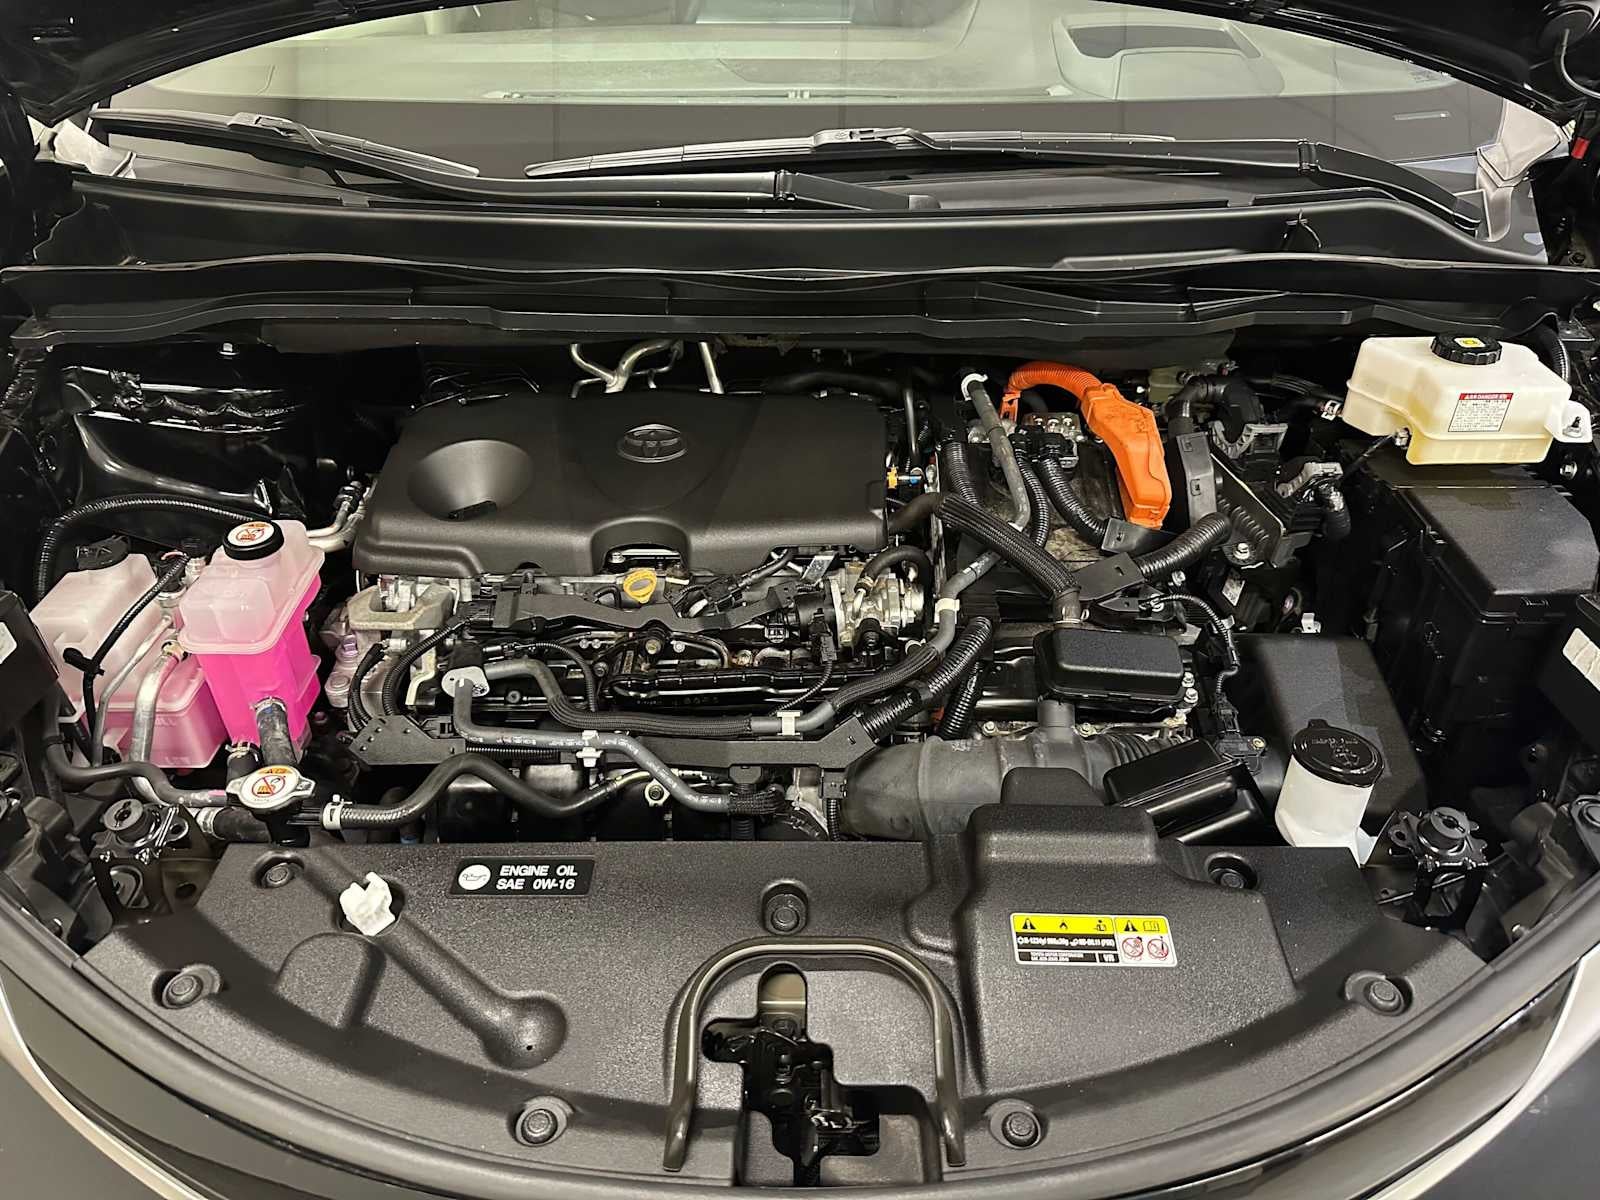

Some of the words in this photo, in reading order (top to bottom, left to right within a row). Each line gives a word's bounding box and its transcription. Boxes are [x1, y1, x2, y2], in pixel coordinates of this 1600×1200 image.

[499, 865, 550, 877] ENGINE
[556, 865, 579, 877] OIL
[496, 878, 525, 890] SAE
[532, 878, 576, 890] 0W-16
